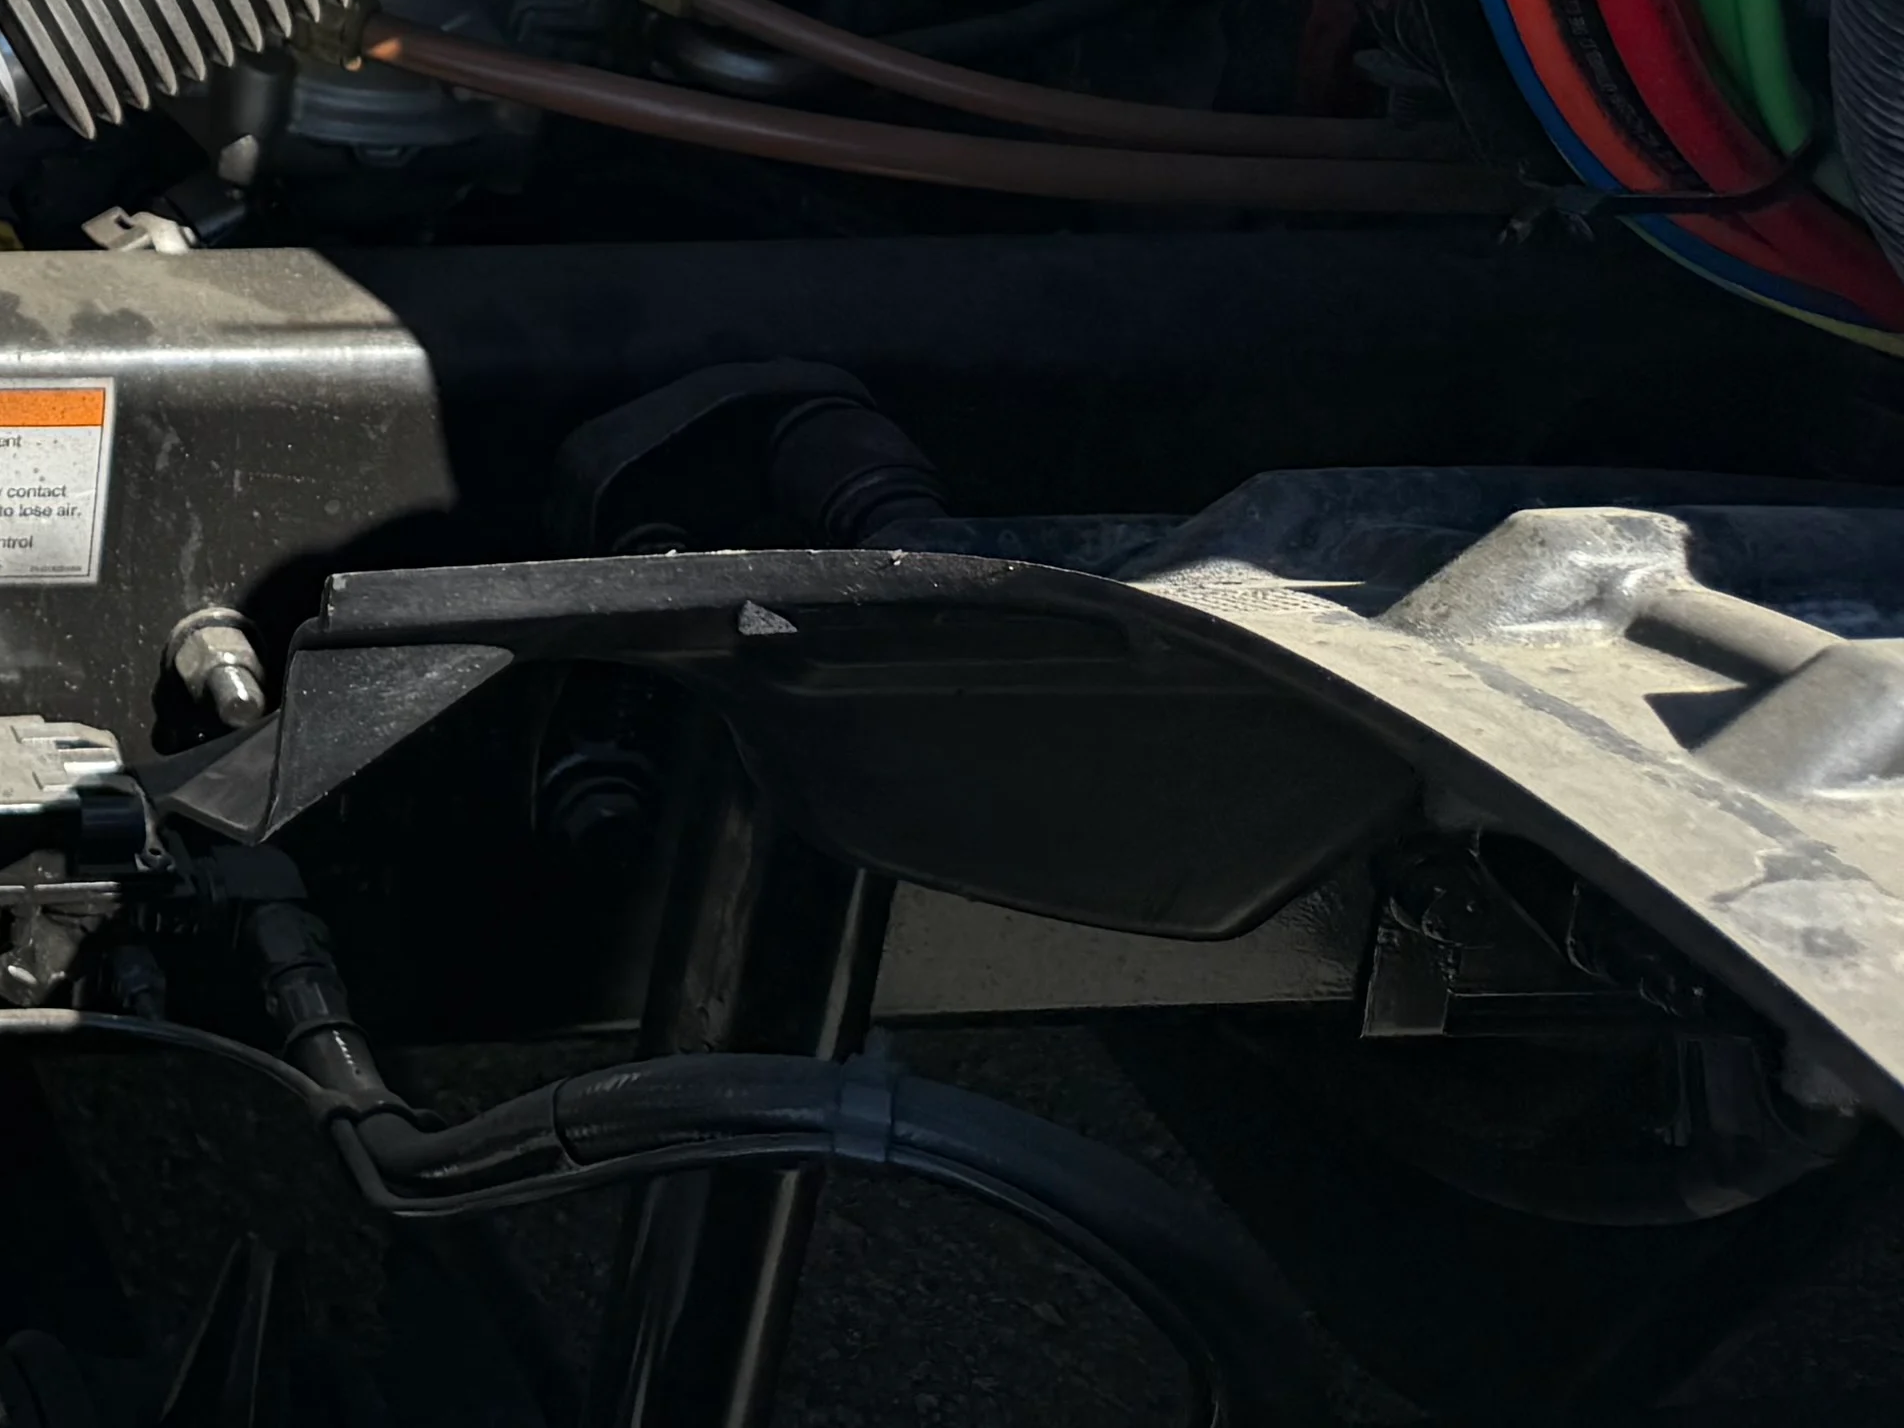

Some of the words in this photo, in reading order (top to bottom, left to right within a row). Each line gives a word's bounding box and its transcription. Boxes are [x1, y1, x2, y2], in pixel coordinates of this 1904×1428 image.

[6, 484, 67, 500] contact
[18, 503, 52, 519] lose
[56, 504, 81, 518] air.
